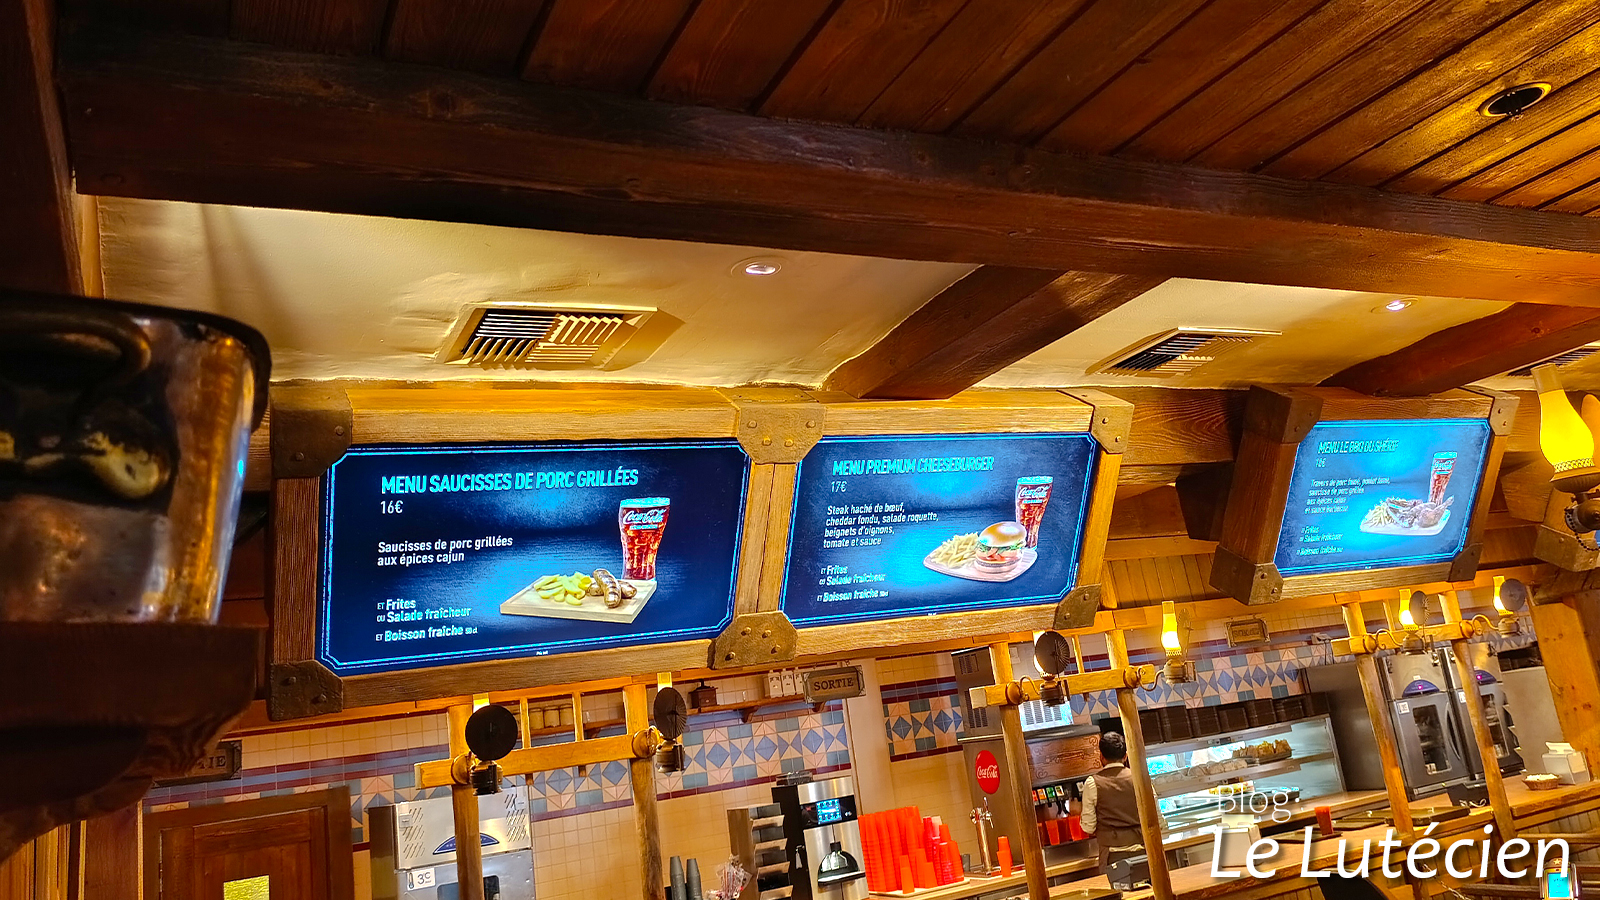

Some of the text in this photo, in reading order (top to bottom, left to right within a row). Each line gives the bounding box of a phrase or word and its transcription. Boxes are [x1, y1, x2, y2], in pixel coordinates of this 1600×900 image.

[1318, 441, 1340, 454] MENU
[1340, 441, 1349, 453] LE
[1349, 440, 1364, 453] BBQ
[1363, 440, 1375, 453] DU
[832, 456, 995, 476] MENU PREMIUM CHEESEBURGER
[381, 466, 639, 495] MENU SAUCISSES DE PORC GRILLÉES
[831, 481, 847, 493] 17€
[380, 500, 404, 514] 16€
[827, 505, 849, 515] Steak
[850, 503, 872, 514] haché
[874, 503, 883, 513] de
[826, 516, 857, 526] cheddar
[882, 513, 906, 524] salade
[824, 527, 856, 539] beignets
[378, 535, 513, 554] Saucisses de porc grillées
[823, 537, 882, 548] tomate et sauce
[377, 551, 465, 568] aux épices cajun
[826, 565, 848, 575] Frites
[823, 592, 852, 602] Boisson
[377, 599, 416, 611] ET Frites
[386, 609, 423, 622] Salade
[425, 607, 472, 620] fraîcheur
[384, 629, 425, 642] Boisson
[428, 625, 463, 639] fraîche
[814, 677, 854, 691] SORTIE
